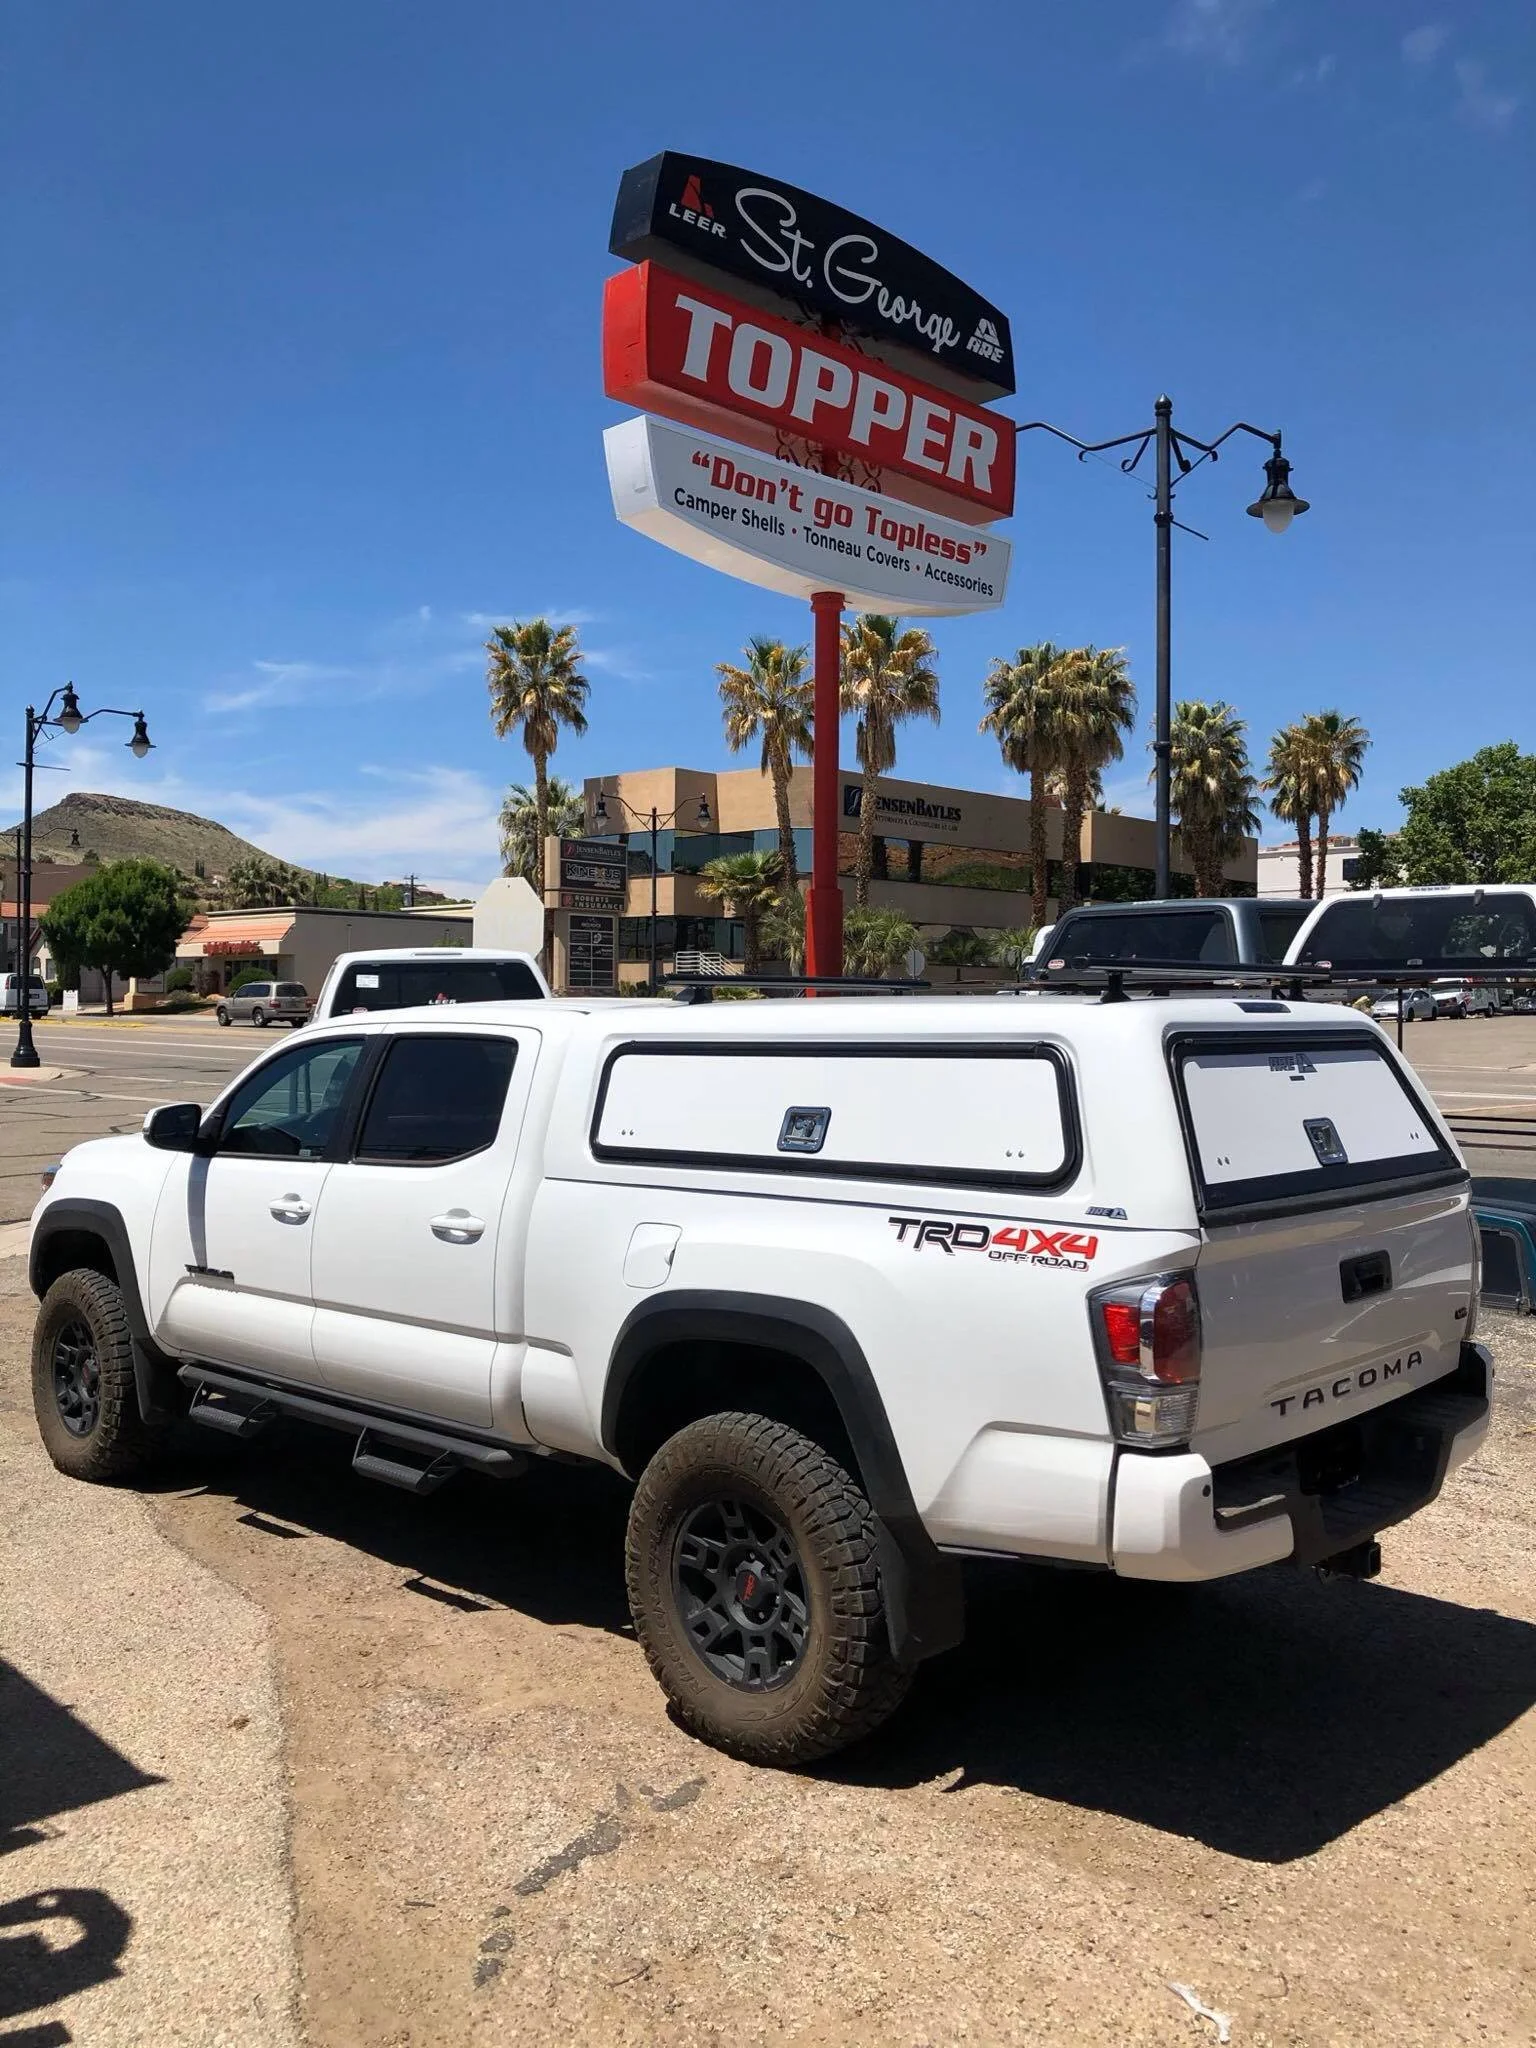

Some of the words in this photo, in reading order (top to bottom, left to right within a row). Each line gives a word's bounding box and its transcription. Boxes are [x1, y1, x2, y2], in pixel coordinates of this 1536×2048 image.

[669, 203, 726, 239] LEER
[735, 187, 815, 288] St.
[824, 234, 960, 353] George
[675, 294, 998, 493] TOPPER
[814, 496, 852, 529] go
[674, 487, 736, 524] Camper
[741, 508, 785, 536] Shells
[803, 526, 861, 559] Tonneau
[866, 545, 910, 573] Covers
[925, 562, 993, 597] Accessories
[574, 895, 609, 903] ROBERTS
[574, 901, 624, 910] INSURANCE
[888, 1217, 990, 1255] TRD
[988, 1250, 1028, 1264] OFF
[1030, 1256, 1089, 1272] ROAD
[1270, 1350, 1422, 1416] TACOMA
